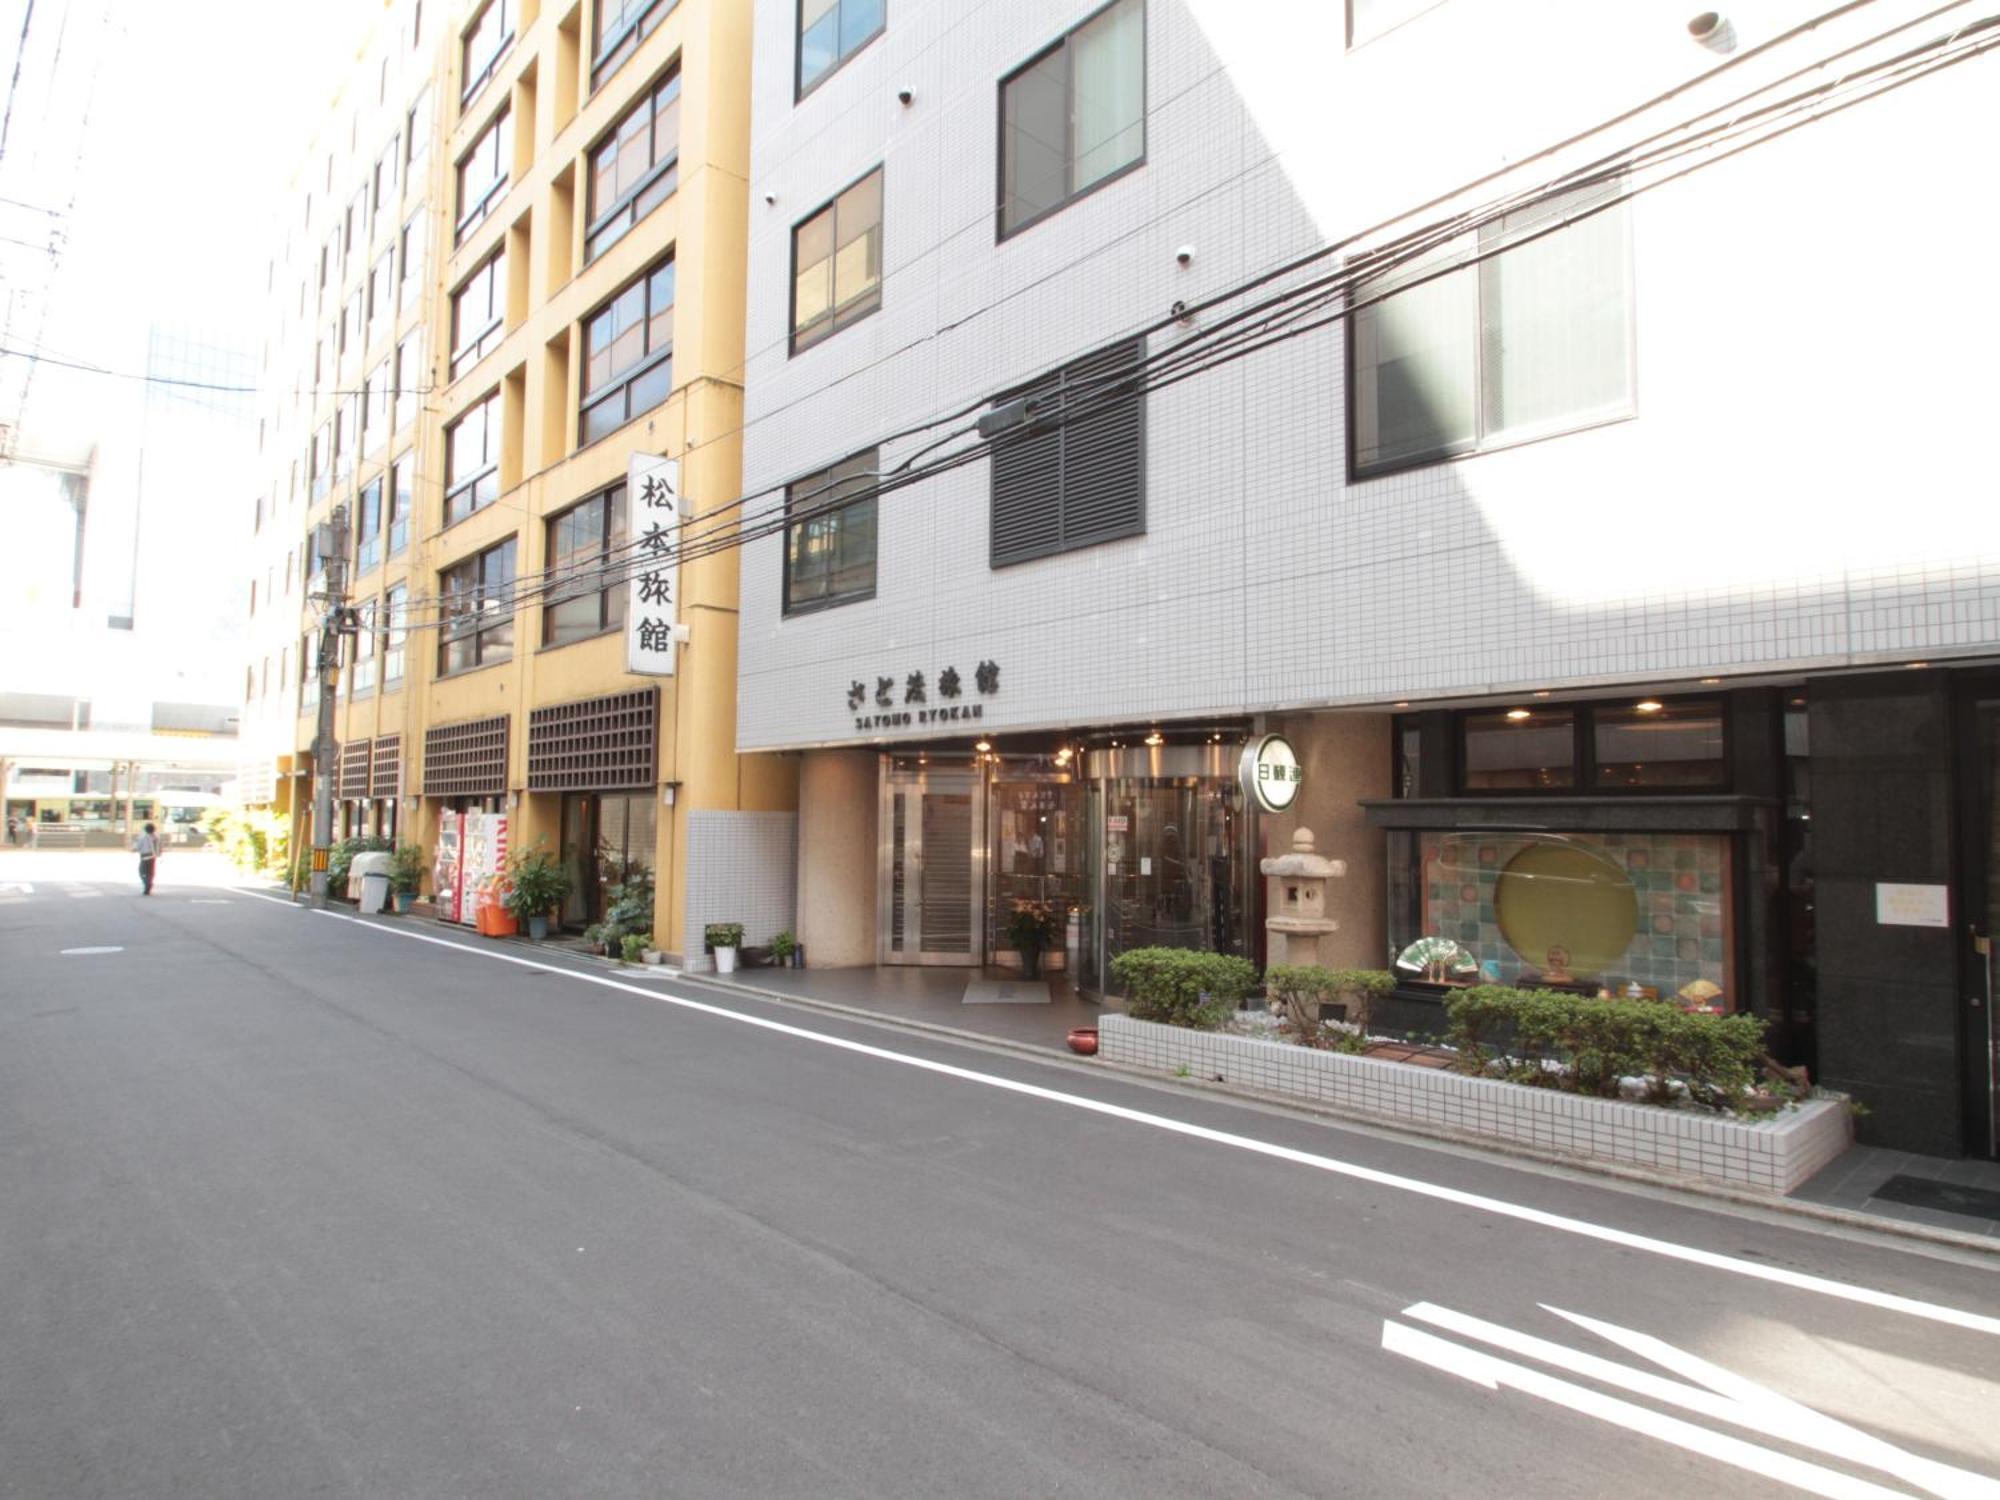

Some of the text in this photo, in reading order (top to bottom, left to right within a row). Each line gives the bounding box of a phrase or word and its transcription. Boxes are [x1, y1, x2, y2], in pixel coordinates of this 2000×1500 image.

[635, 474, 675, 653] 松本旅館
[855, 704, 983, 730] SATOMO RYOKAN
